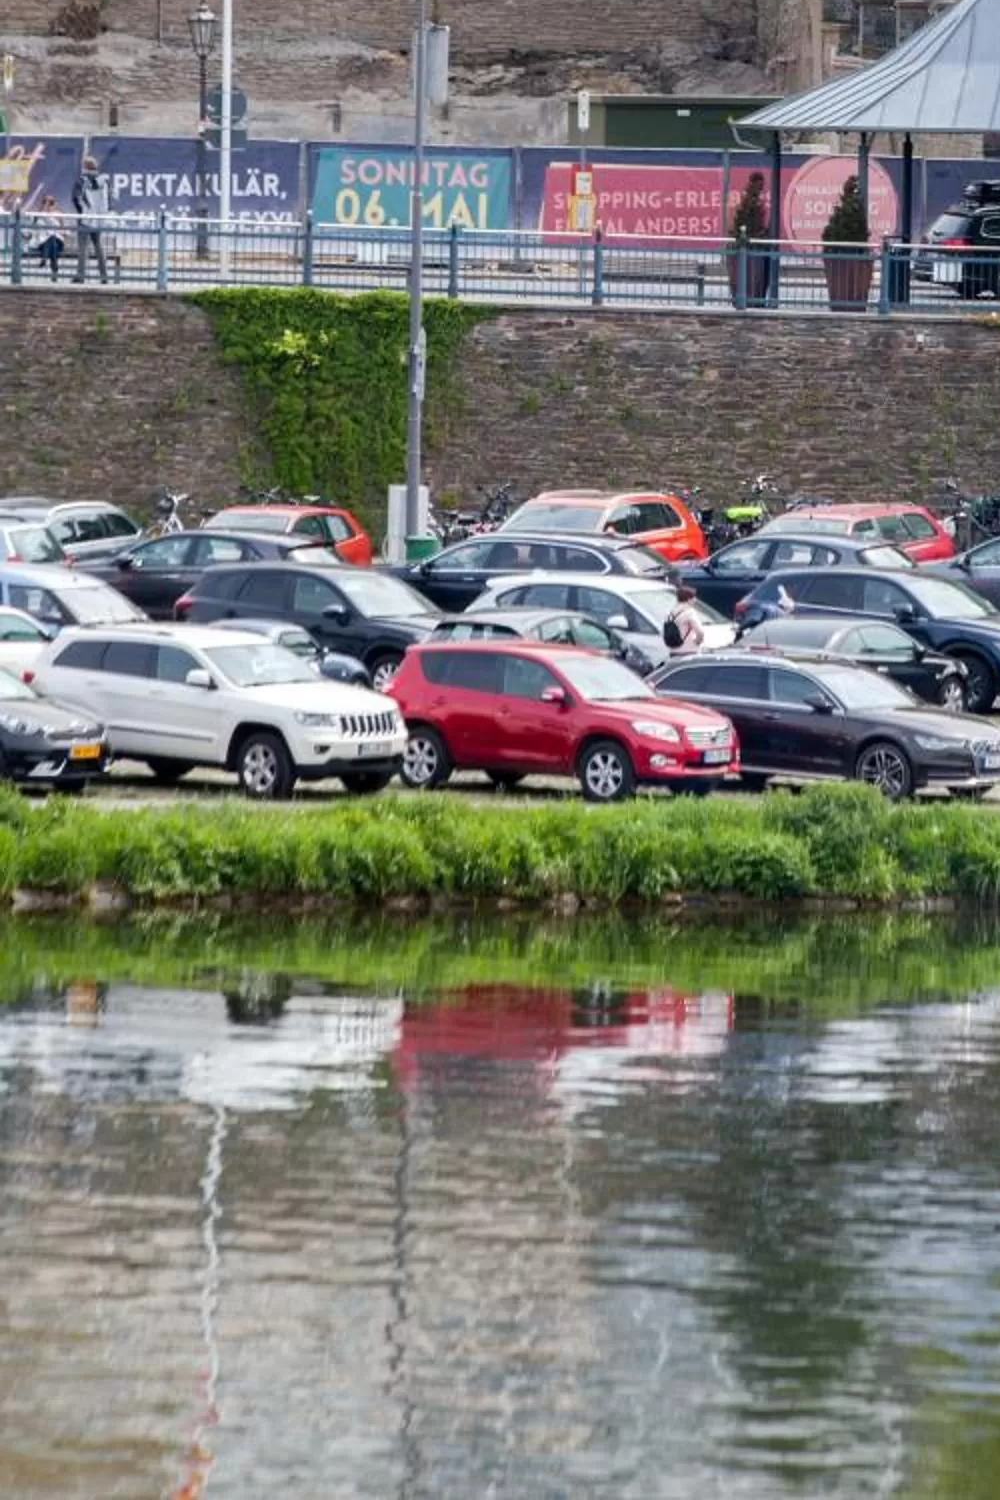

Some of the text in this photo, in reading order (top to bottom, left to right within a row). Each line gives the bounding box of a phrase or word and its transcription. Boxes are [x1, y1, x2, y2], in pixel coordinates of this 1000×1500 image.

[340, 159, 489, 188] SONNTAG
[335, 188, 488, 229] 06. MAI
[633, 215, 719, 234] ANDERS!
